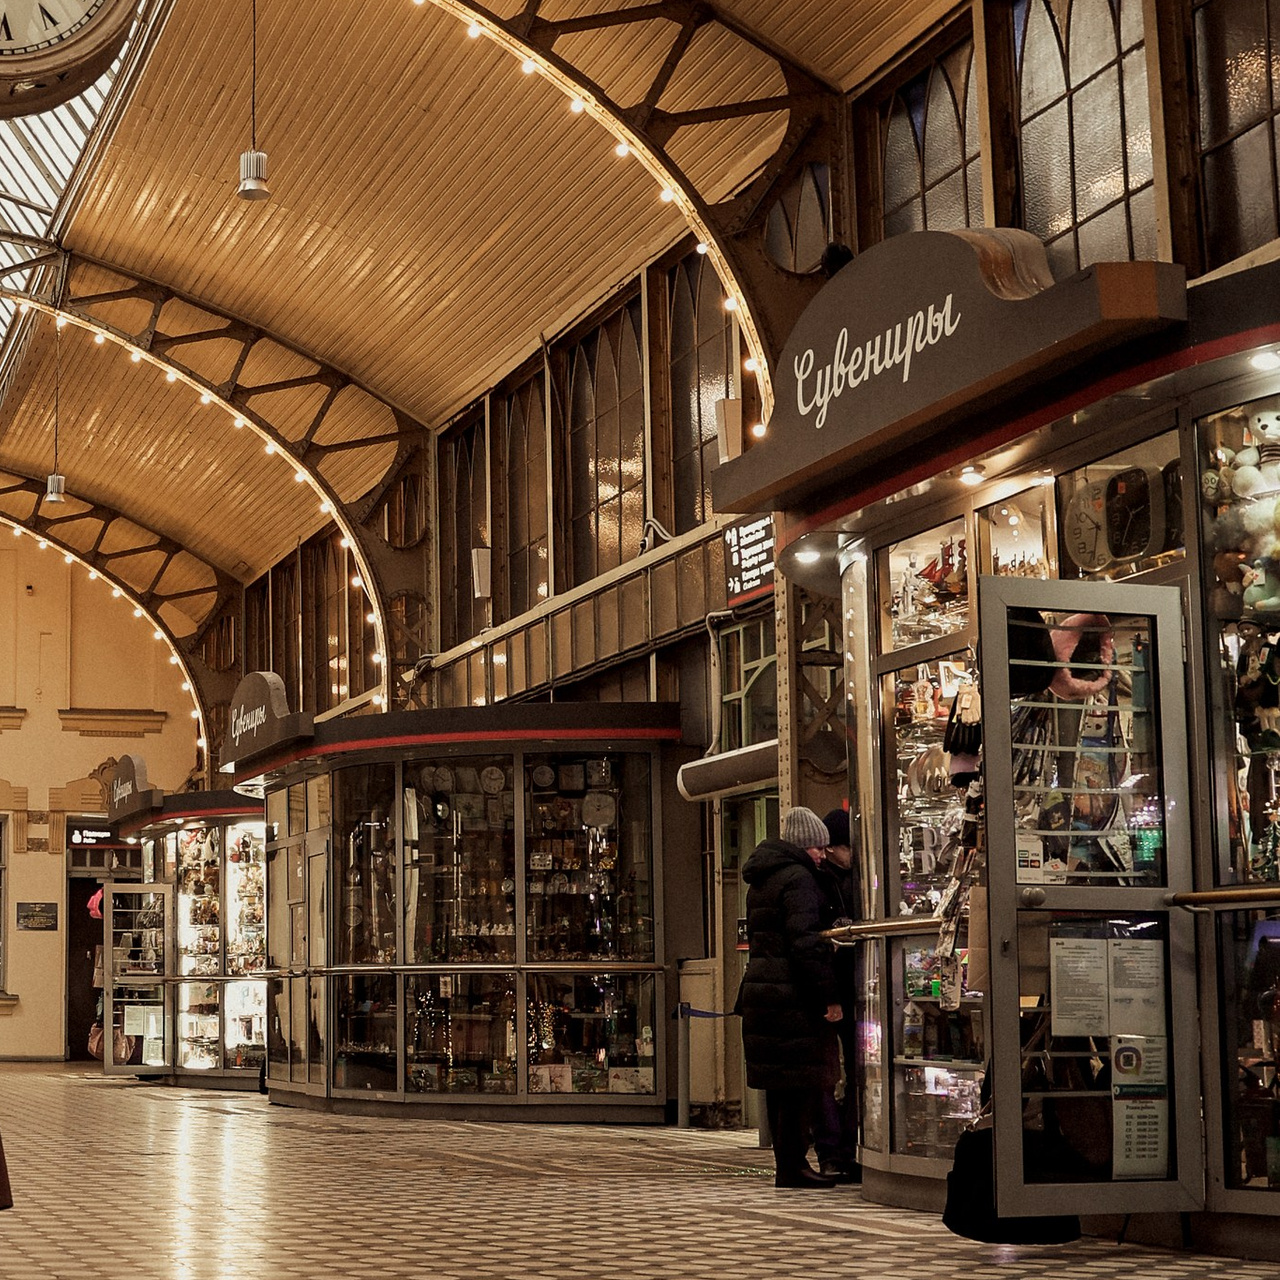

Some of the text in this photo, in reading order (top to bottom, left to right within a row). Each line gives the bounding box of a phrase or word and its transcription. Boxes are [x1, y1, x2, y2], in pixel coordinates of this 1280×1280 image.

[38, 2, 60, 31] V
[793, 293, 962, 429] Сувениры
[231, 704, 267, 747] Сувениры
